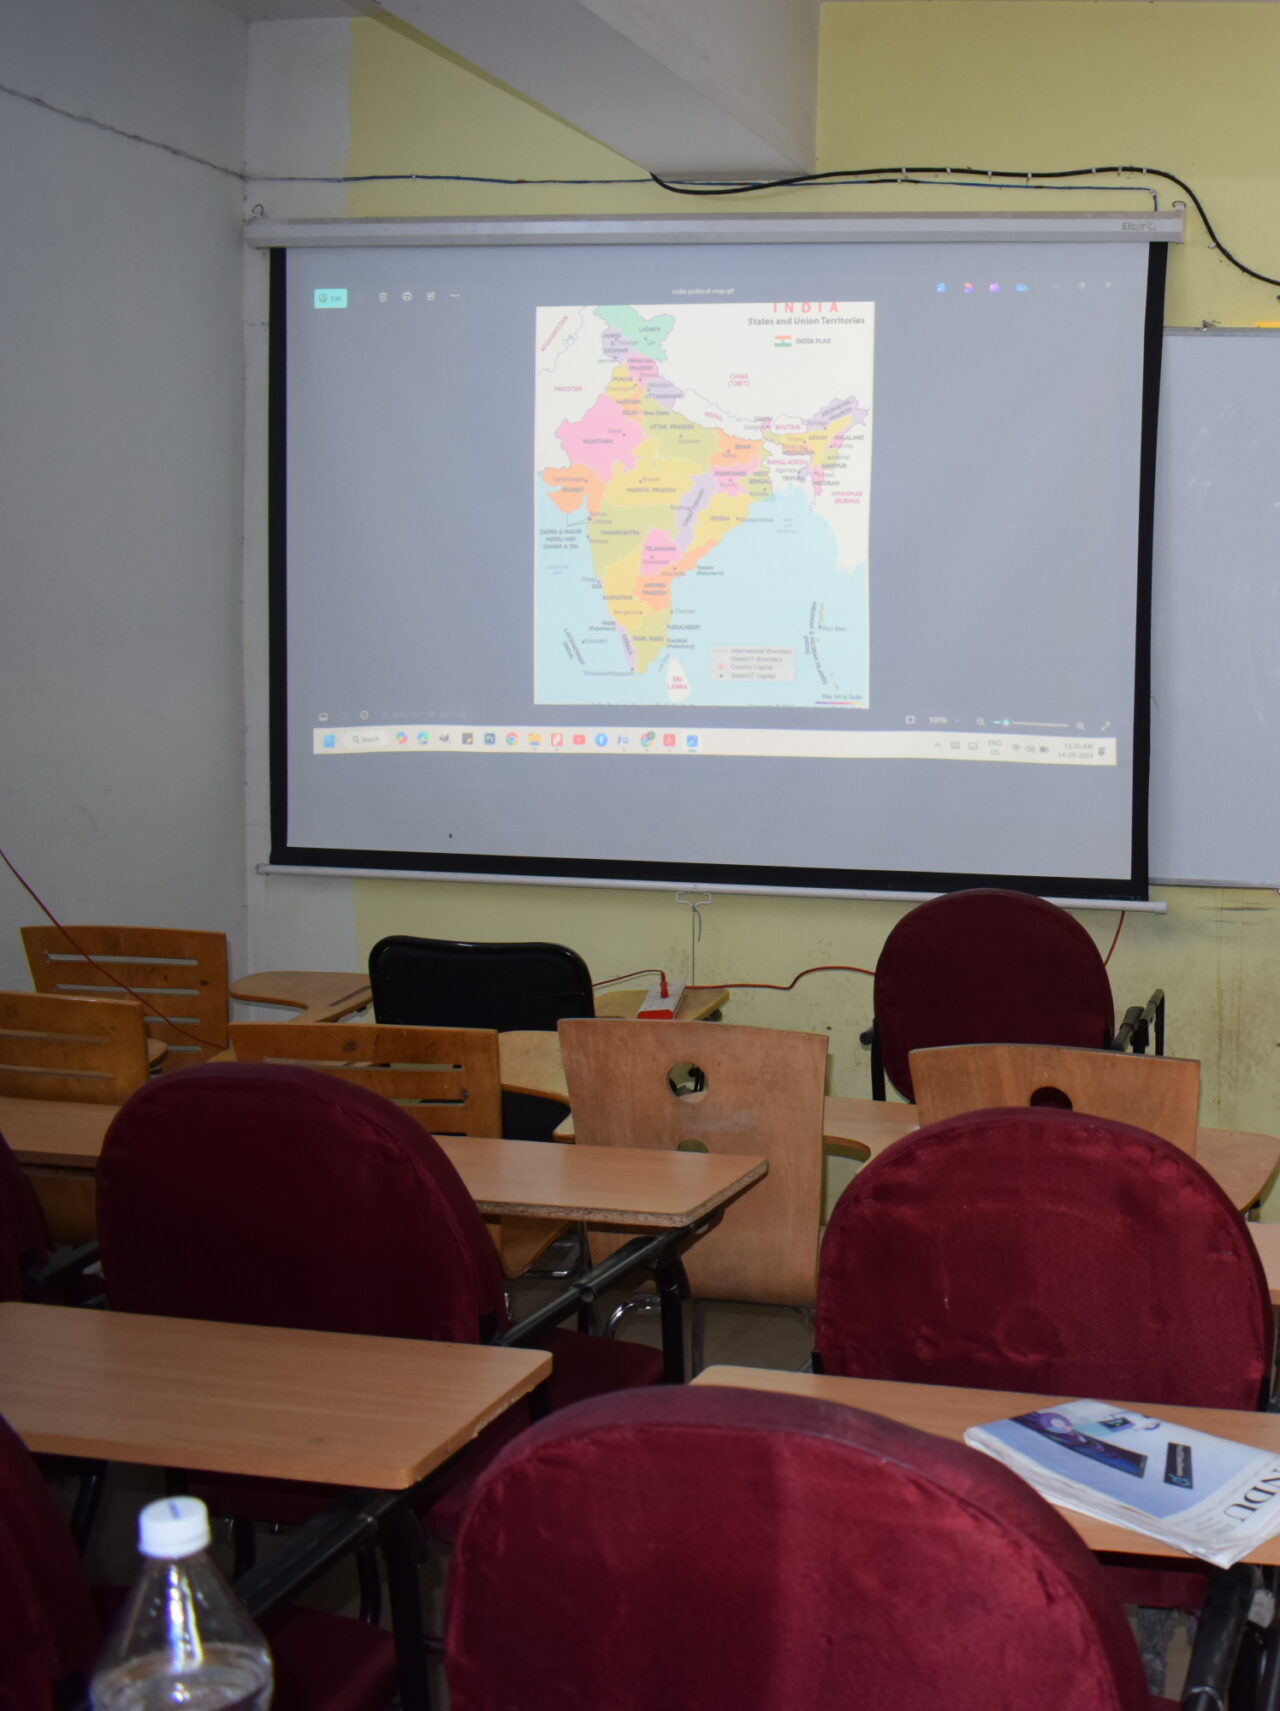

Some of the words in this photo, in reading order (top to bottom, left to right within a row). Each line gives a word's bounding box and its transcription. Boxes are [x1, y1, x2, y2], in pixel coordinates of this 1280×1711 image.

[773, 301, 838, 313] INDIA
[748, 317, 774, 326] States
[776, 317, 792, 326] and
[794, 316, 820, 325] Union
[821, 316, 865, 325] Territories
